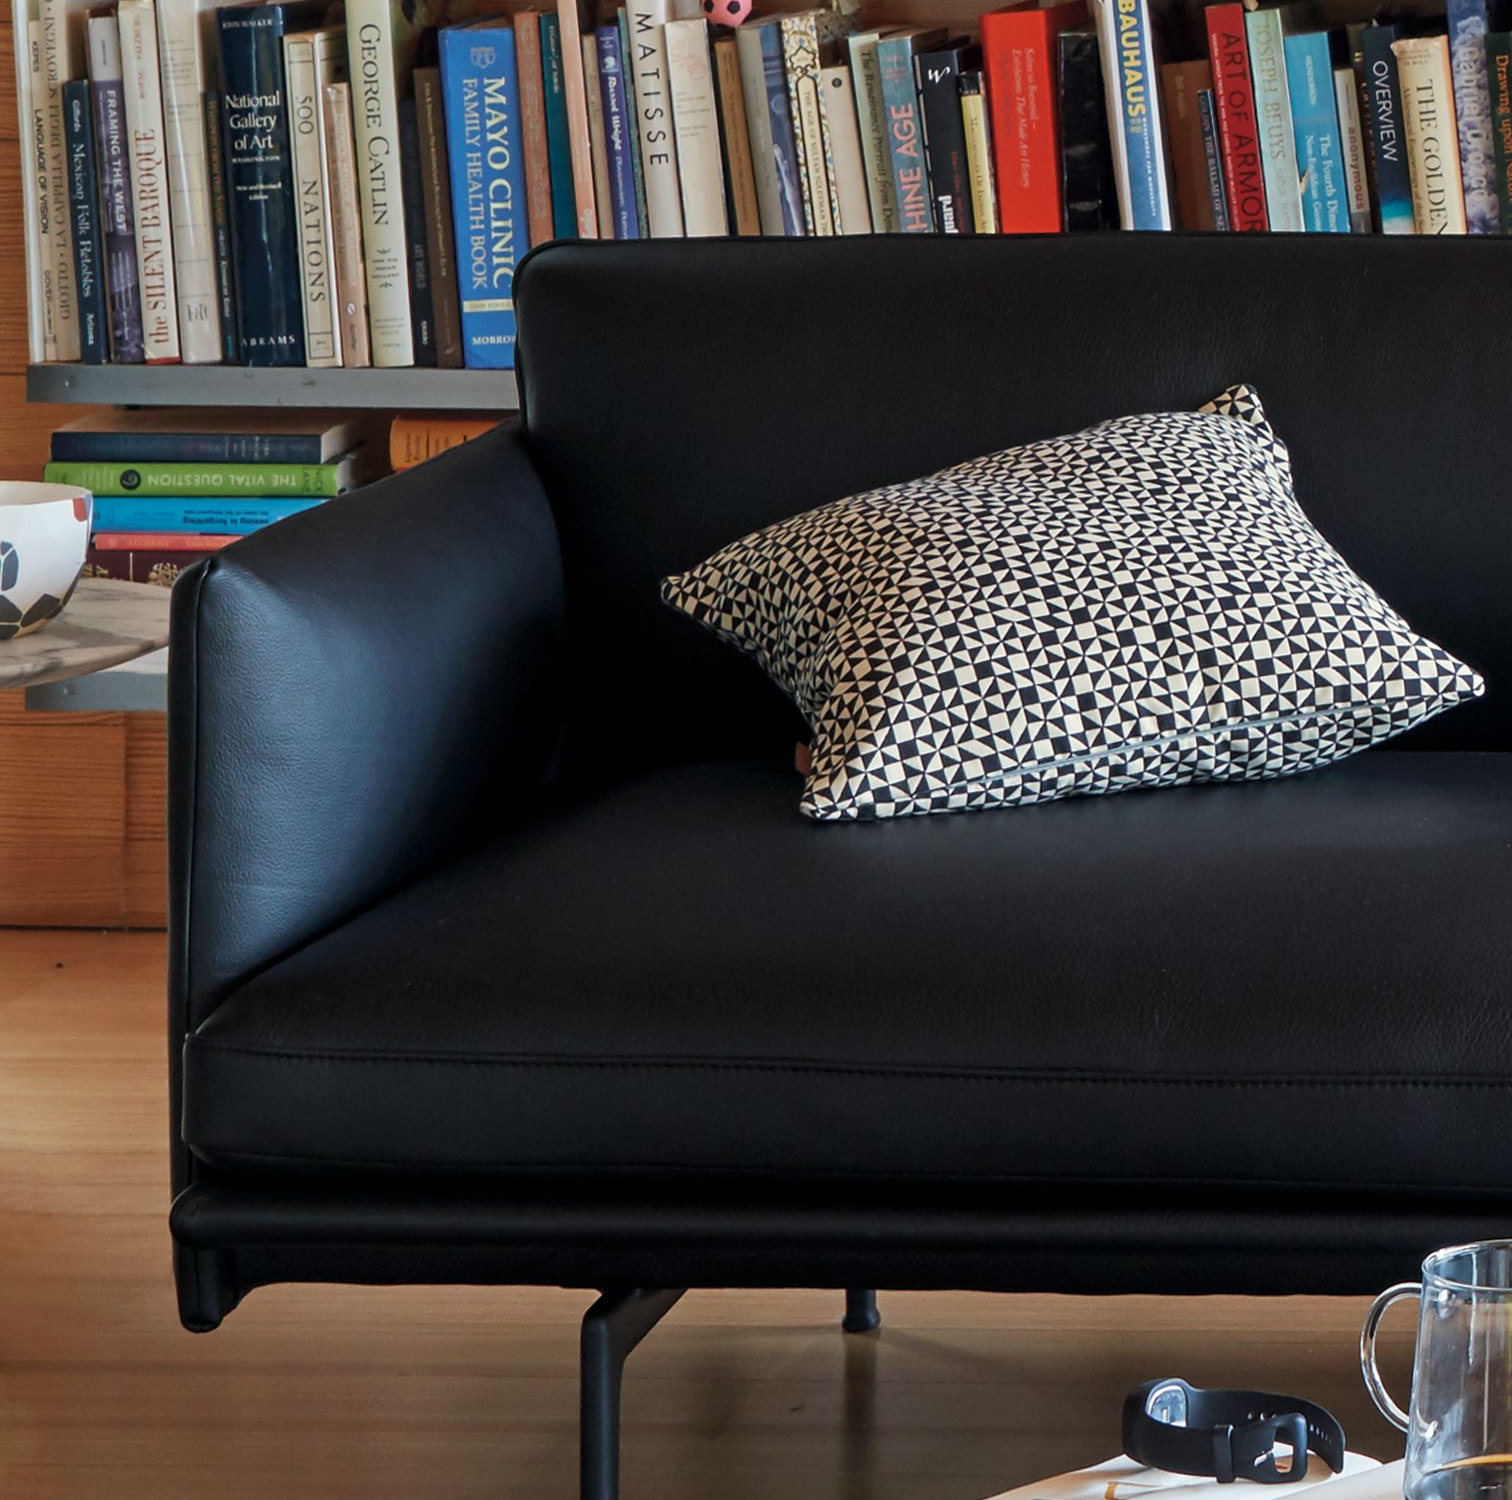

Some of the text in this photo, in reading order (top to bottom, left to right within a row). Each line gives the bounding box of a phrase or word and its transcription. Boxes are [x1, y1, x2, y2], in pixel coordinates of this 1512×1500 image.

[360, 23, 389, 225] GEORGE CATLIN
[463, 78, 488, 289] FAMILY HEALTH BOOK
[484, 77, 514, 288] MAYO CLINIC
[634, 11, 669, 166] MATISSE
[1372, 60, 1396, 162] OVERVIEW
[297, 95, 327, 303] 500 NATIONS
[148, 476, 296, 486] THE VITAL QUESTION
